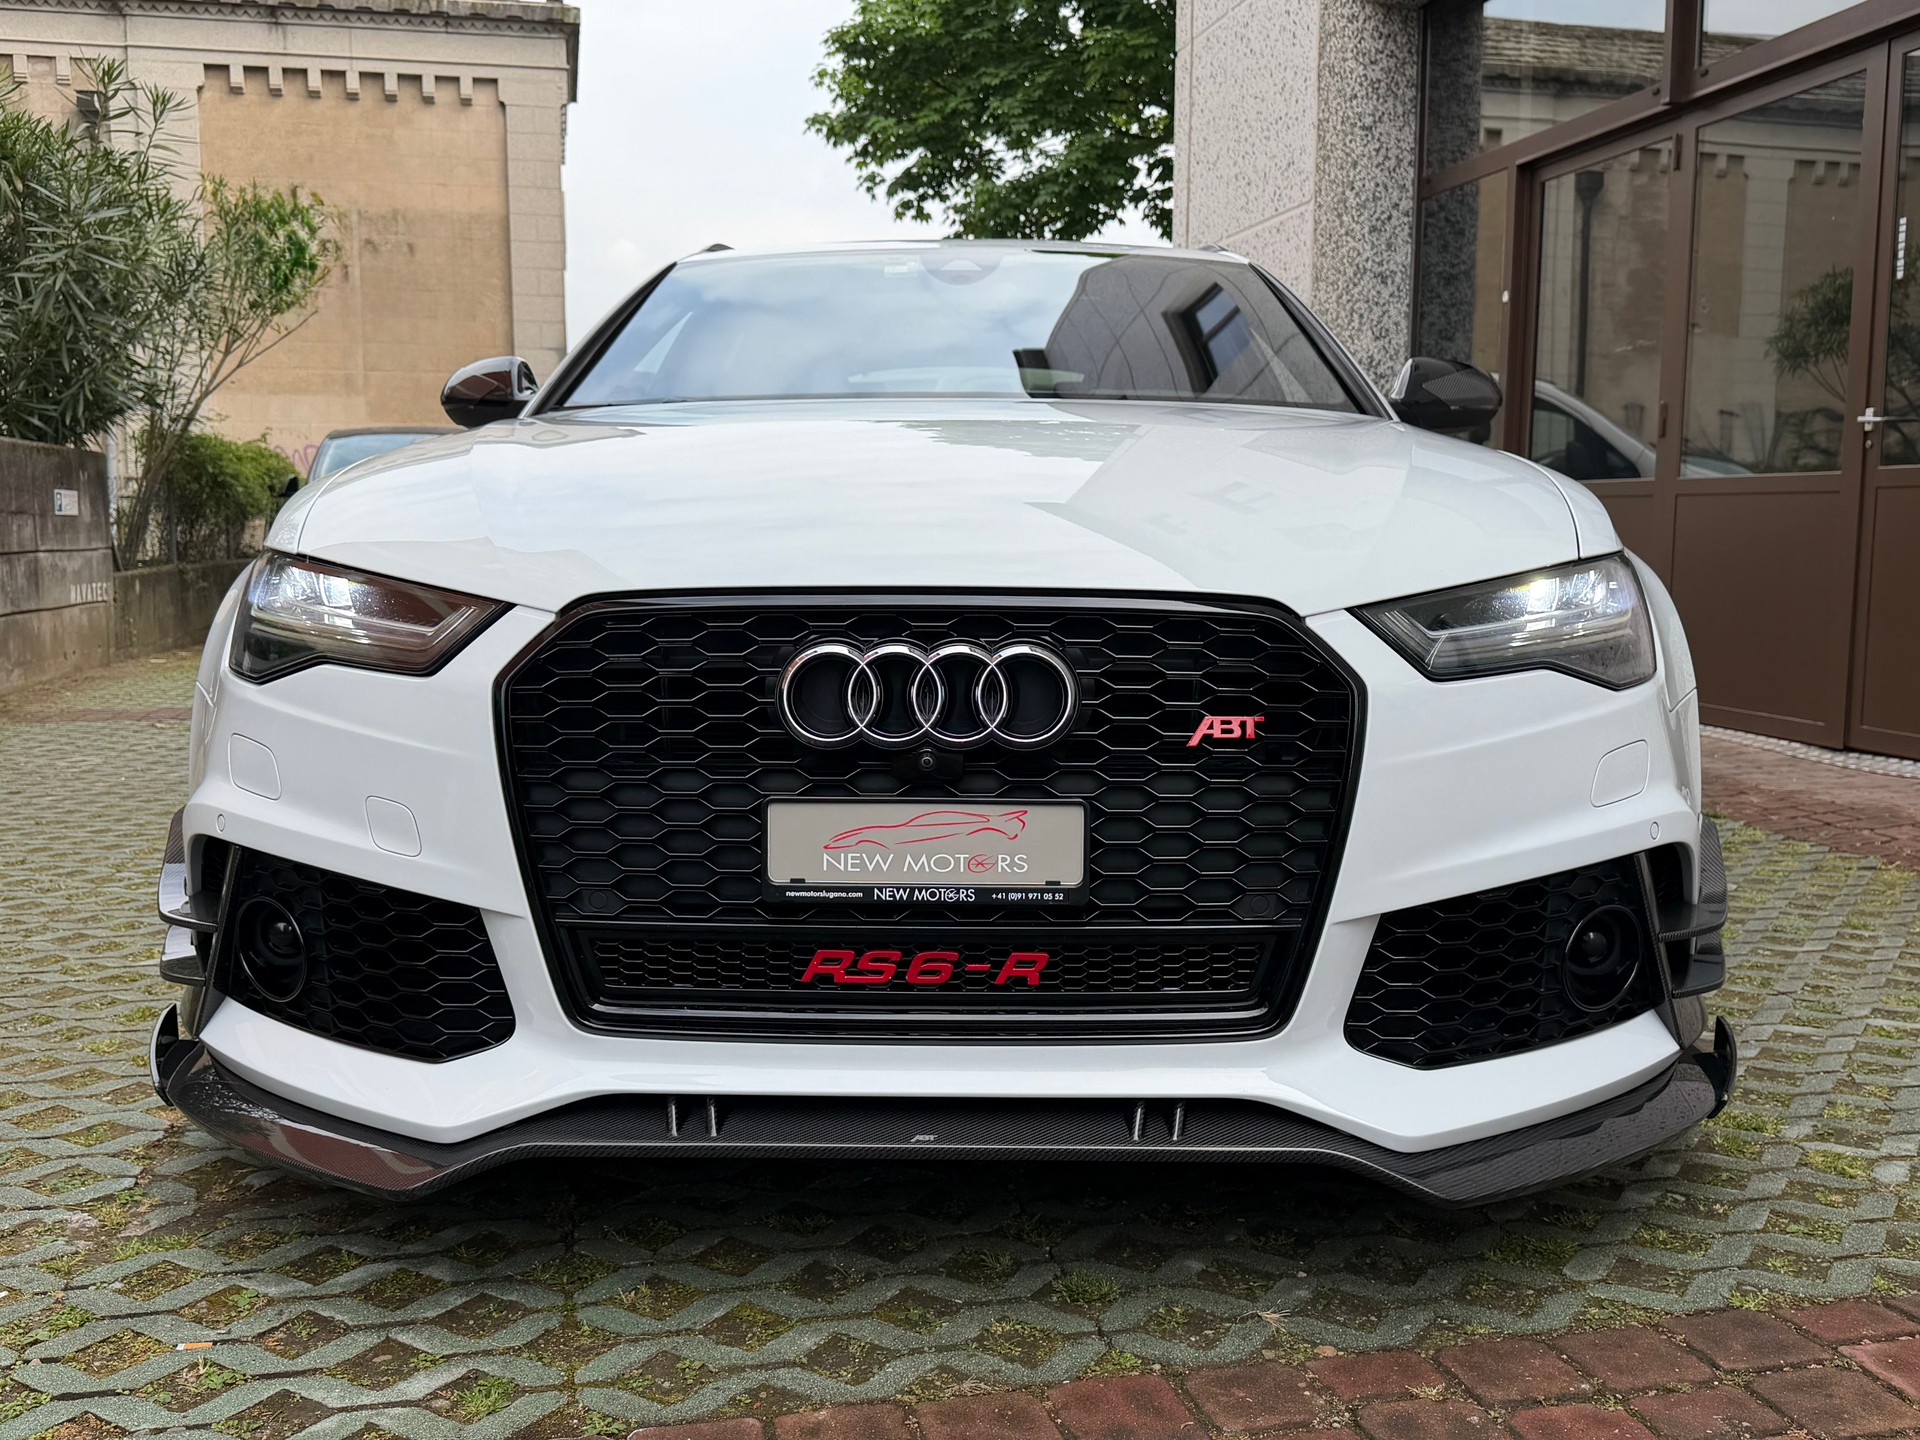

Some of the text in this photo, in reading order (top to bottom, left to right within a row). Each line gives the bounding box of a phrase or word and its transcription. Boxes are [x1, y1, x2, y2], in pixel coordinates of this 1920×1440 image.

[1186, 716, 1264, 747] ABT
[823, 853, 1028, 873] NEW MOTORS
[785, 890, 863, 899] newmotorslugano.com
[874, 888, 975, 902] NEW MOTORS
[991, 892, 1006, 900] +41
[1008, 892, 1025, 901] (0)91
